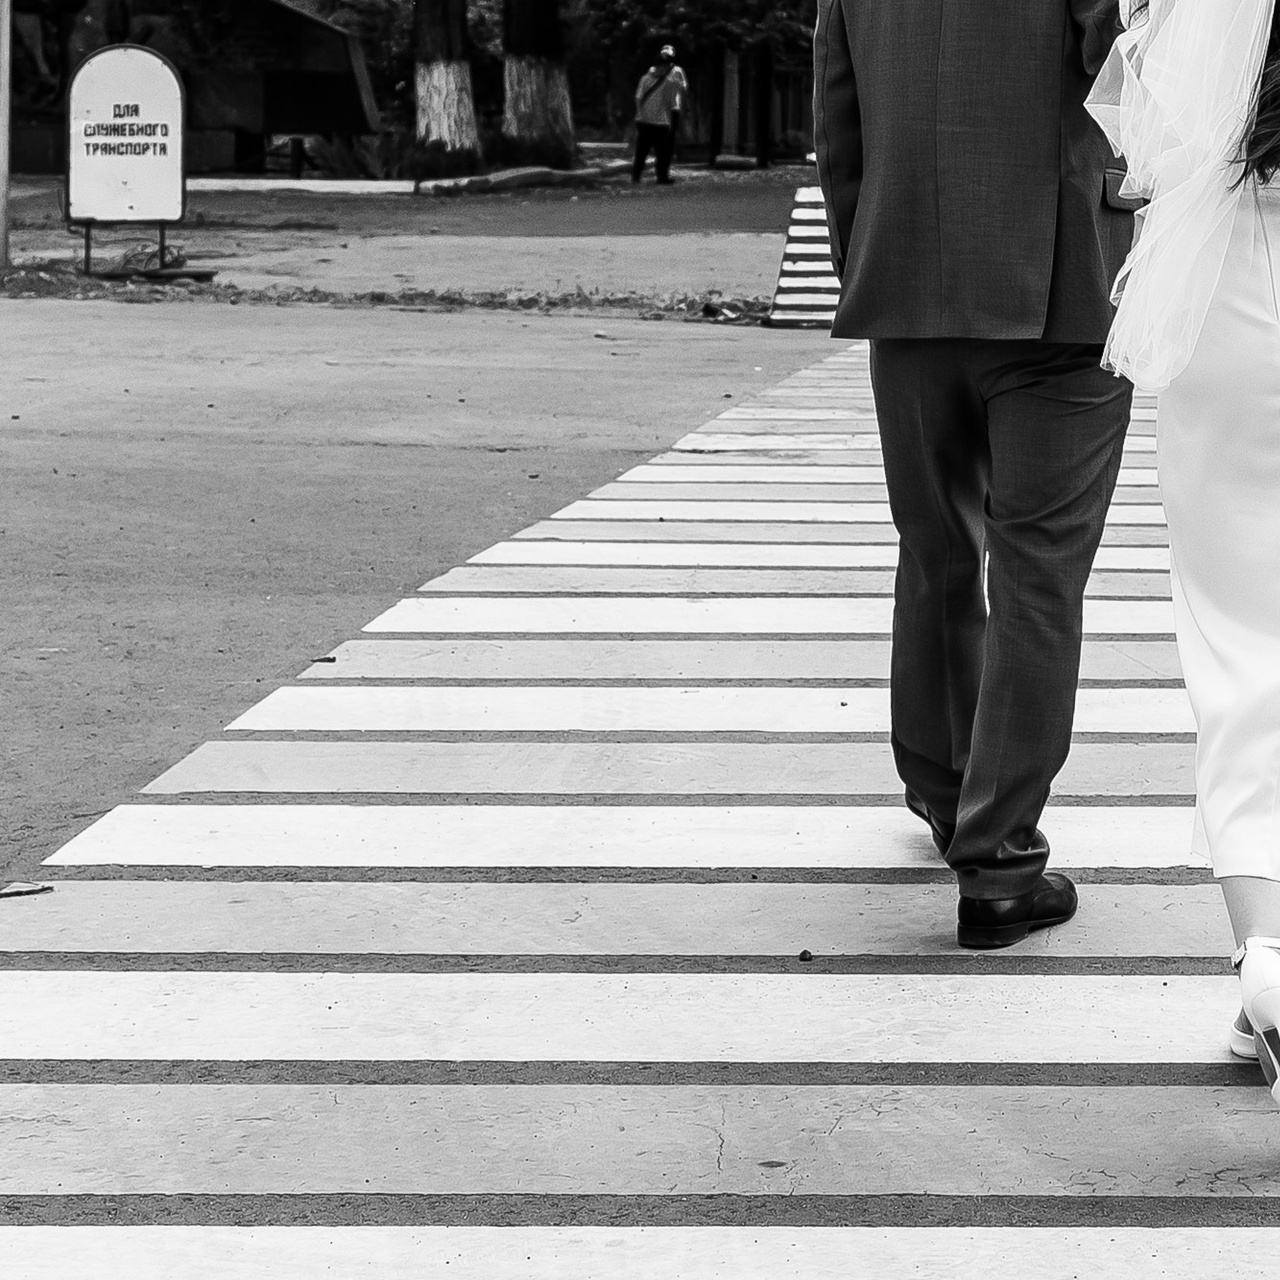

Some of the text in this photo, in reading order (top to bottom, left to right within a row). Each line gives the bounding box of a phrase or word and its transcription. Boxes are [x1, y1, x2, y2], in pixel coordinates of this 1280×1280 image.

[113, 103, 140, 119] ДЛЯ
[83, 122, 169, 138] СЛУЖЕБНОГО
[84, 142, 168, 156] ТРАНСПОРТА
